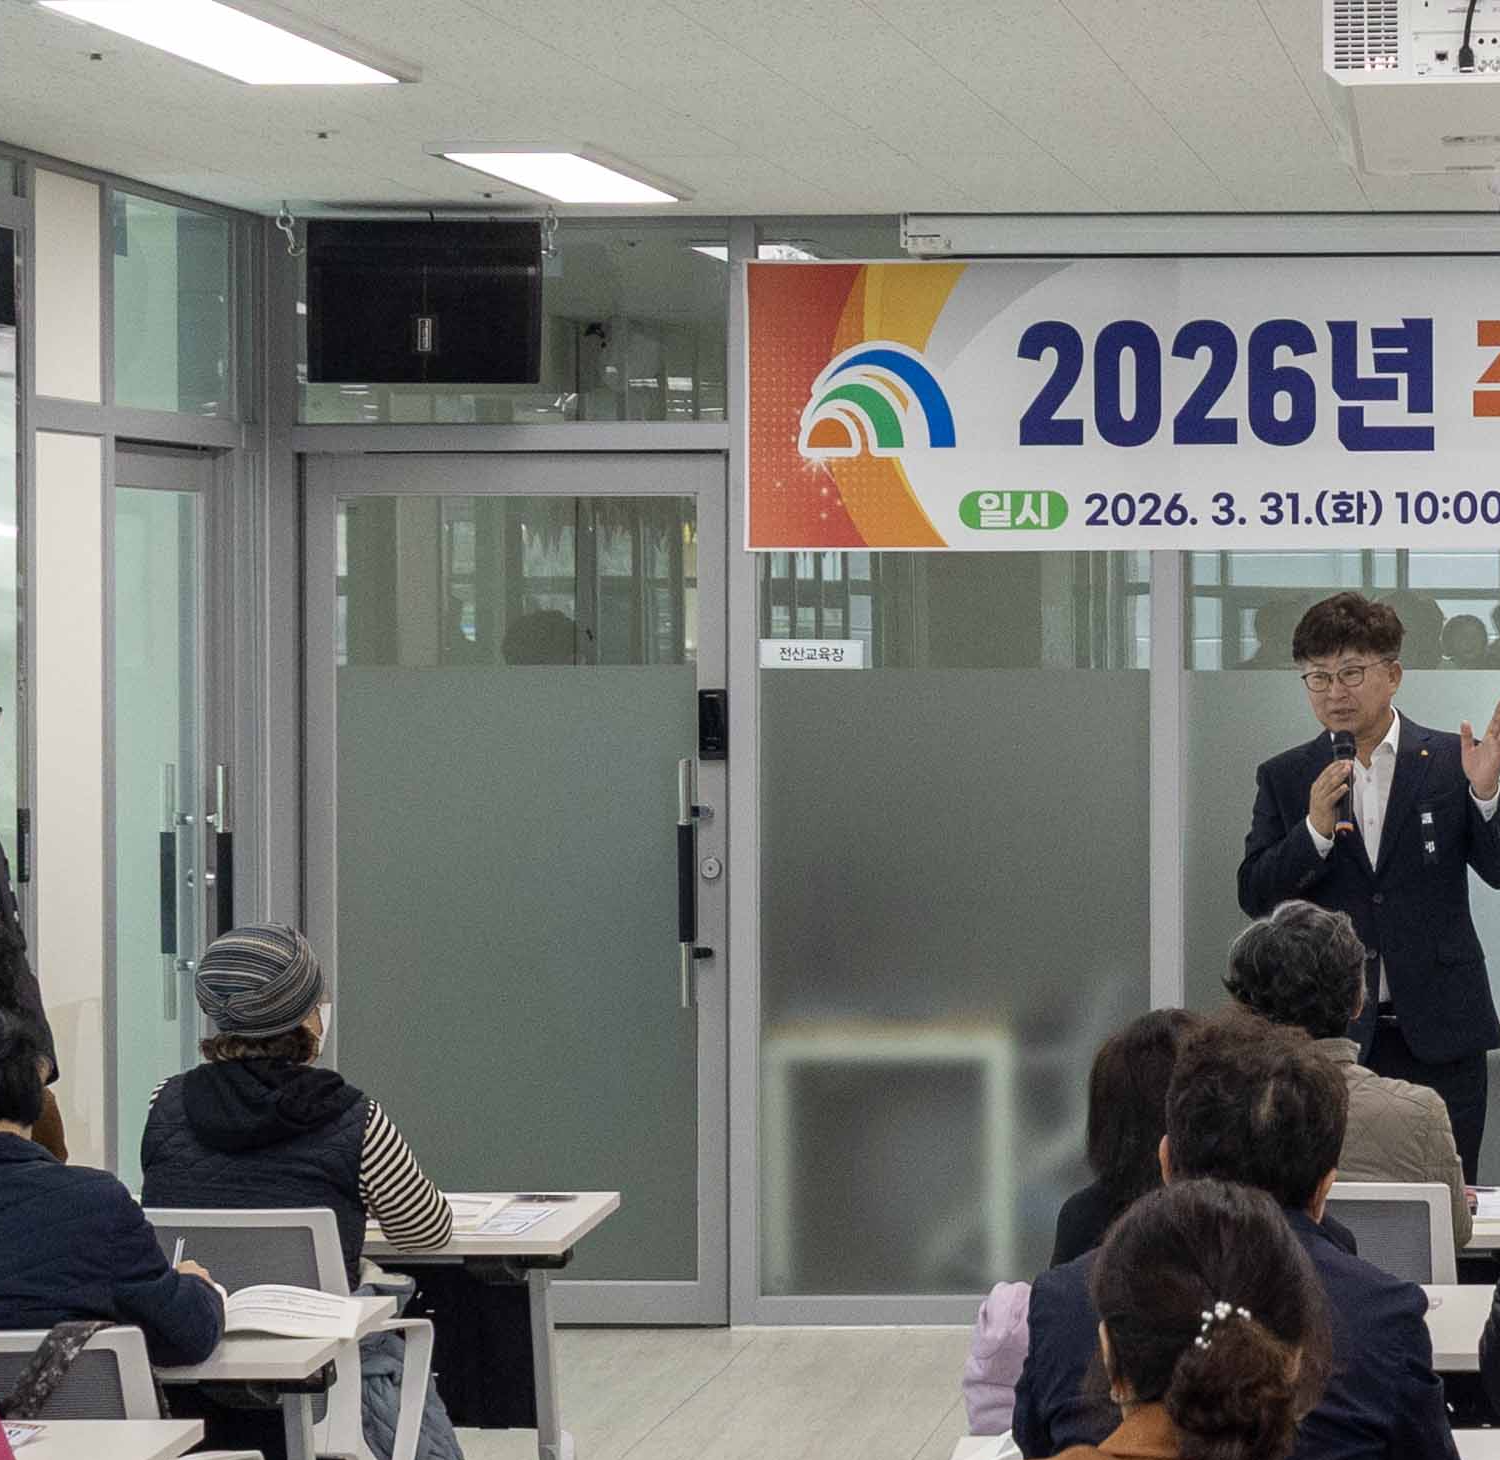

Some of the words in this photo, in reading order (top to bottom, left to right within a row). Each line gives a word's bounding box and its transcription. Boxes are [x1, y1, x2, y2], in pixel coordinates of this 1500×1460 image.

[1017, 317, 1435, 452] 2026년
[976, 492, 1051, 529] 일시
[1085, 492, 1196, 527] 2026.
[1211, 492, 1247, 526] 3.
[1260, 490, 1383, 527] 31.(화)
[779, 647, 844, 663] 전산교육장
